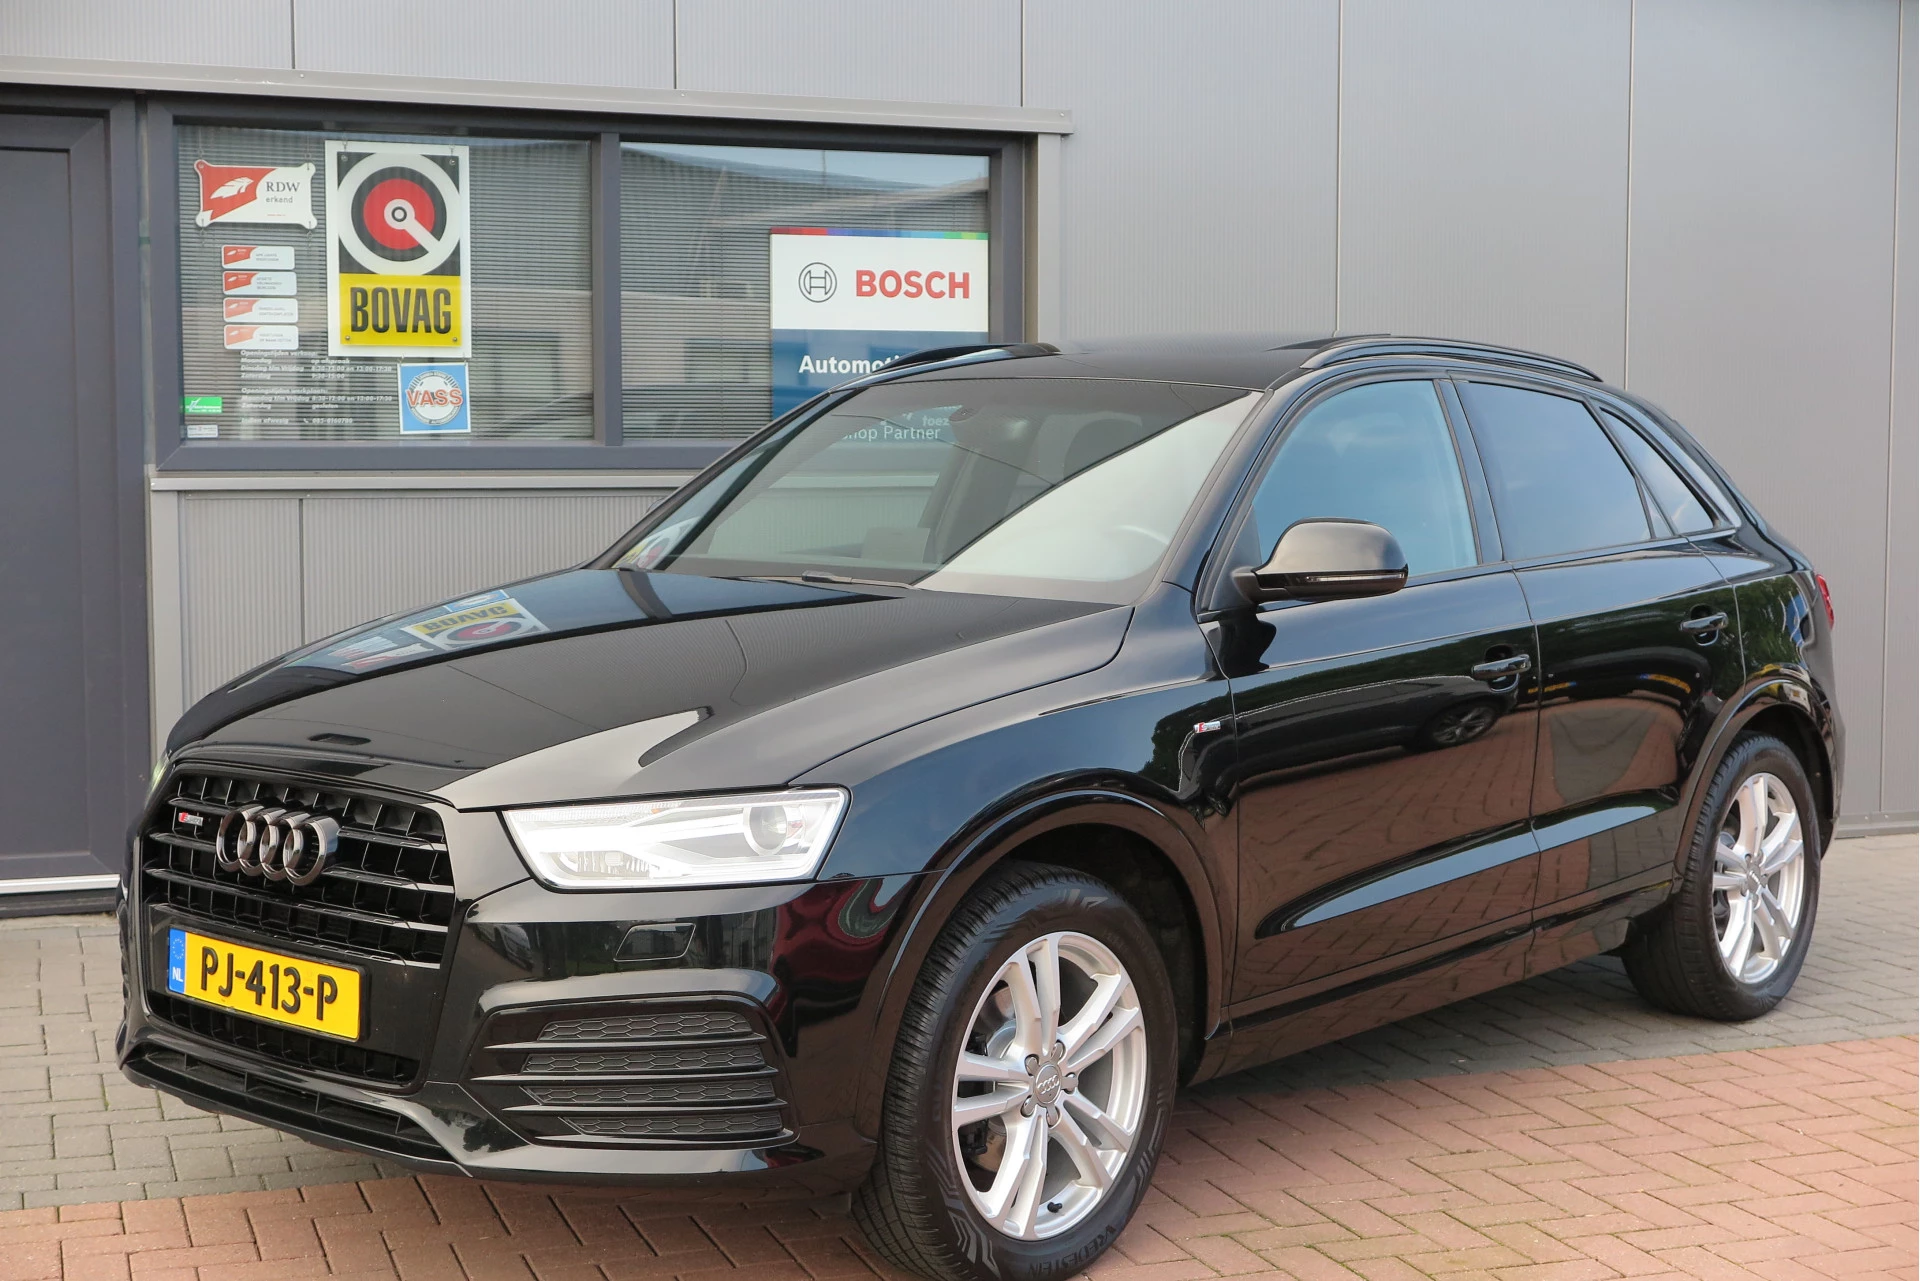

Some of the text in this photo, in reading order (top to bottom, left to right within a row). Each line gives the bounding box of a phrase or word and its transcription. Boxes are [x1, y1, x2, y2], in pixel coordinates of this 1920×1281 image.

[266, 181, 301, 193] RDW
[855, 269, 970, 299] BOSCH
[350, 286, 452, 335] BOVAG
[405, 388, 463, 406] VASS
[884, 425, 941, 439] Partner
[172, 966, 184, 983] NL
[200, 946, 338, 1021] PJ-413-P
